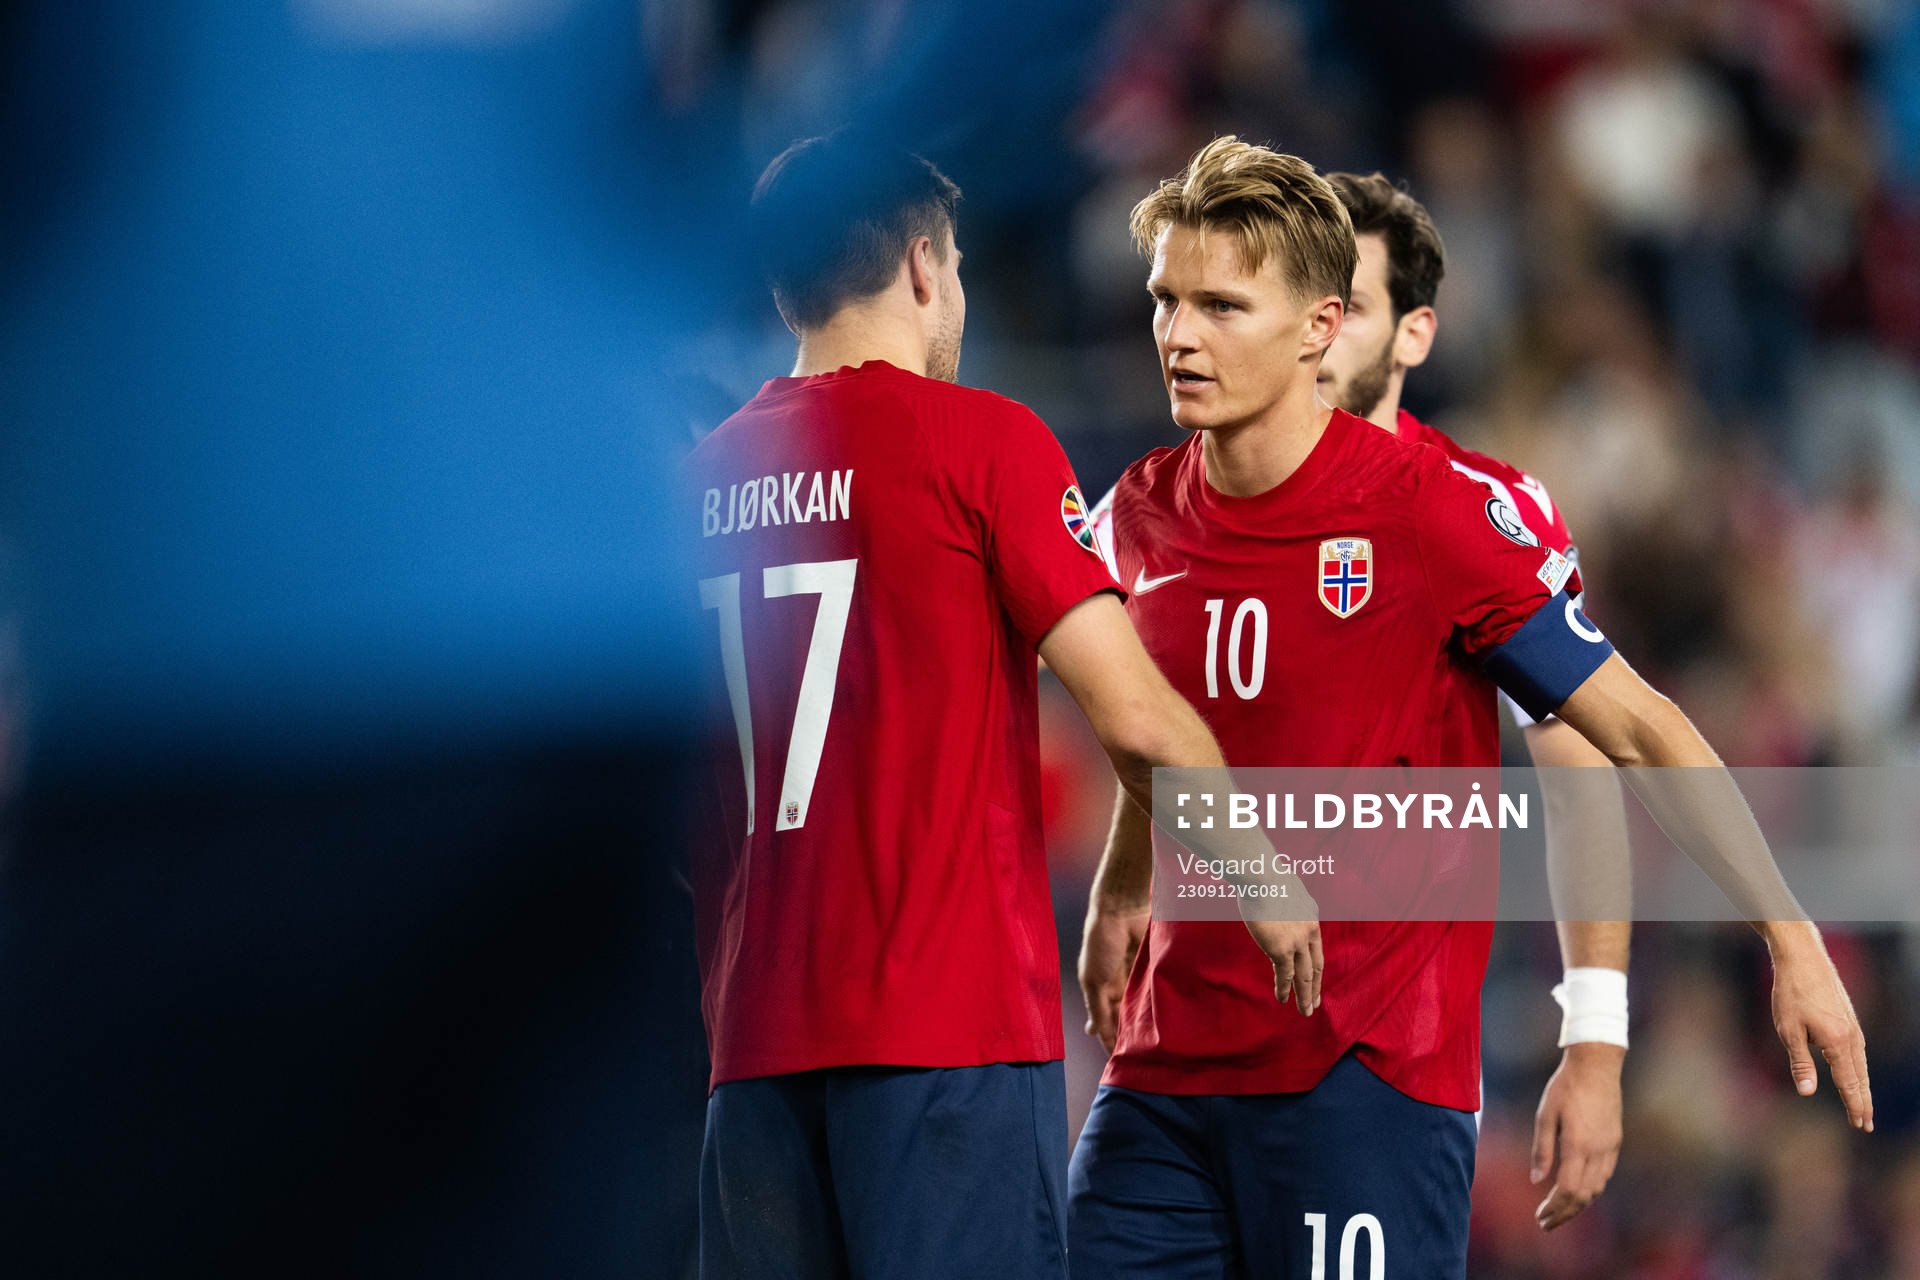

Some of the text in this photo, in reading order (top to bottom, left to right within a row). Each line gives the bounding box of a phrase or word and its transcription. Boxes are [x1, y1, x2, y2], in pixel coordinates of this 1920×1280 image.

[703, 469, 853, 538] BJØRKAN
[1204, 597, 1268, 700] 10
[699, 558, 858, 836] 17
[1304, 1212, 1385, 1280] 10
